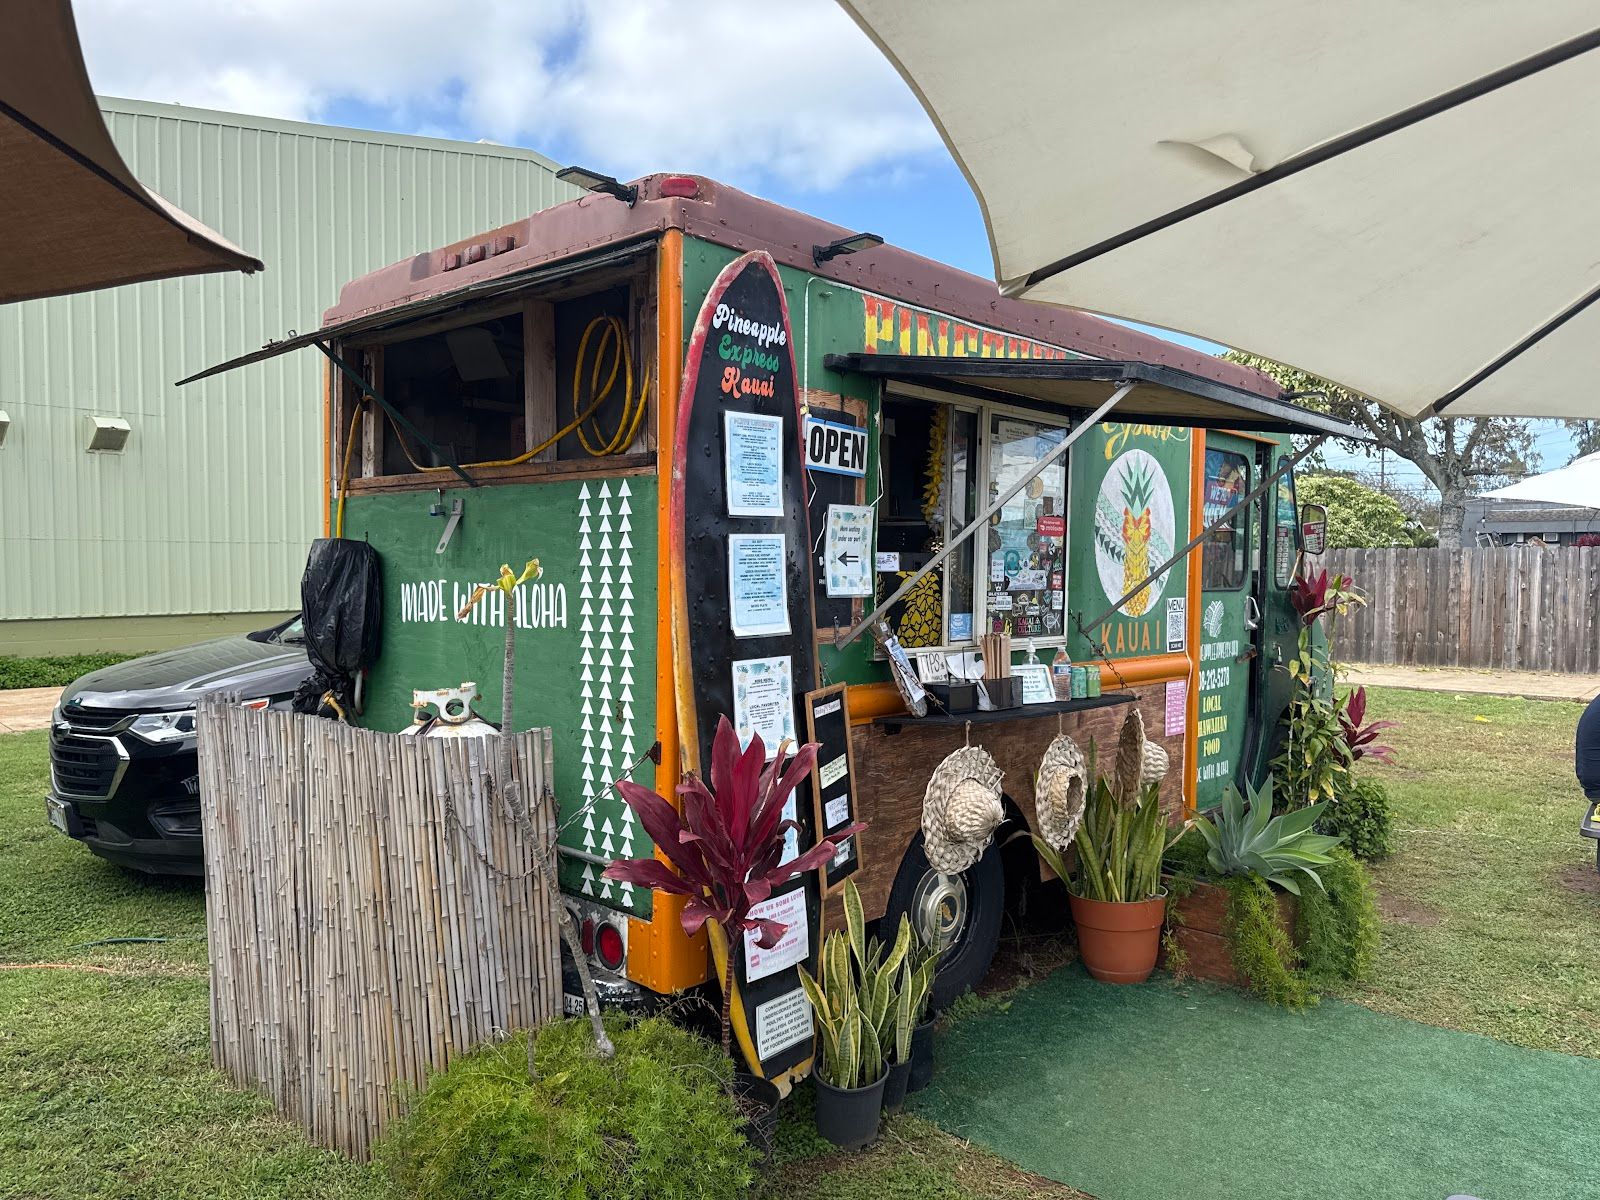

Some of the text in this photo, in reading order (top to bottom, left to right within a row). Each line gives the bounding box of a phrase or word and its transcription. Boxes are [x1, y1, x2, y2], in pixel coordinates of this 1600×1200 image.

[712, 303, 786, 348] Pineapple
[718, 333, 779, 372] Express
[721, 366, 775, 399] Kauai
[810, 425, 866, 470] OPEN
[401, 579, 568, 629] MADE WITH ALOHA
[1167, 599, 1185, 611] MENU
[1101, 620, 1160, 655] KAUAI
[918, 653, 940, 674] TIPS
[1202, 695, 1222, 713] LOCAL
[1197, 715, 1228, 738] HAWAIIAN
[1203, 738, 1220, 757] FOOD
[766, 902, 774, 911] US
[775, 897, 790, 908] SOME
[575, 999, 582, 1013] 25
[762, 1004, 792, 1021] UNDERCOOKED
[770, 1028, 790, 1041] INCREASE
[790, 1023, 801, 1031] YOUR
